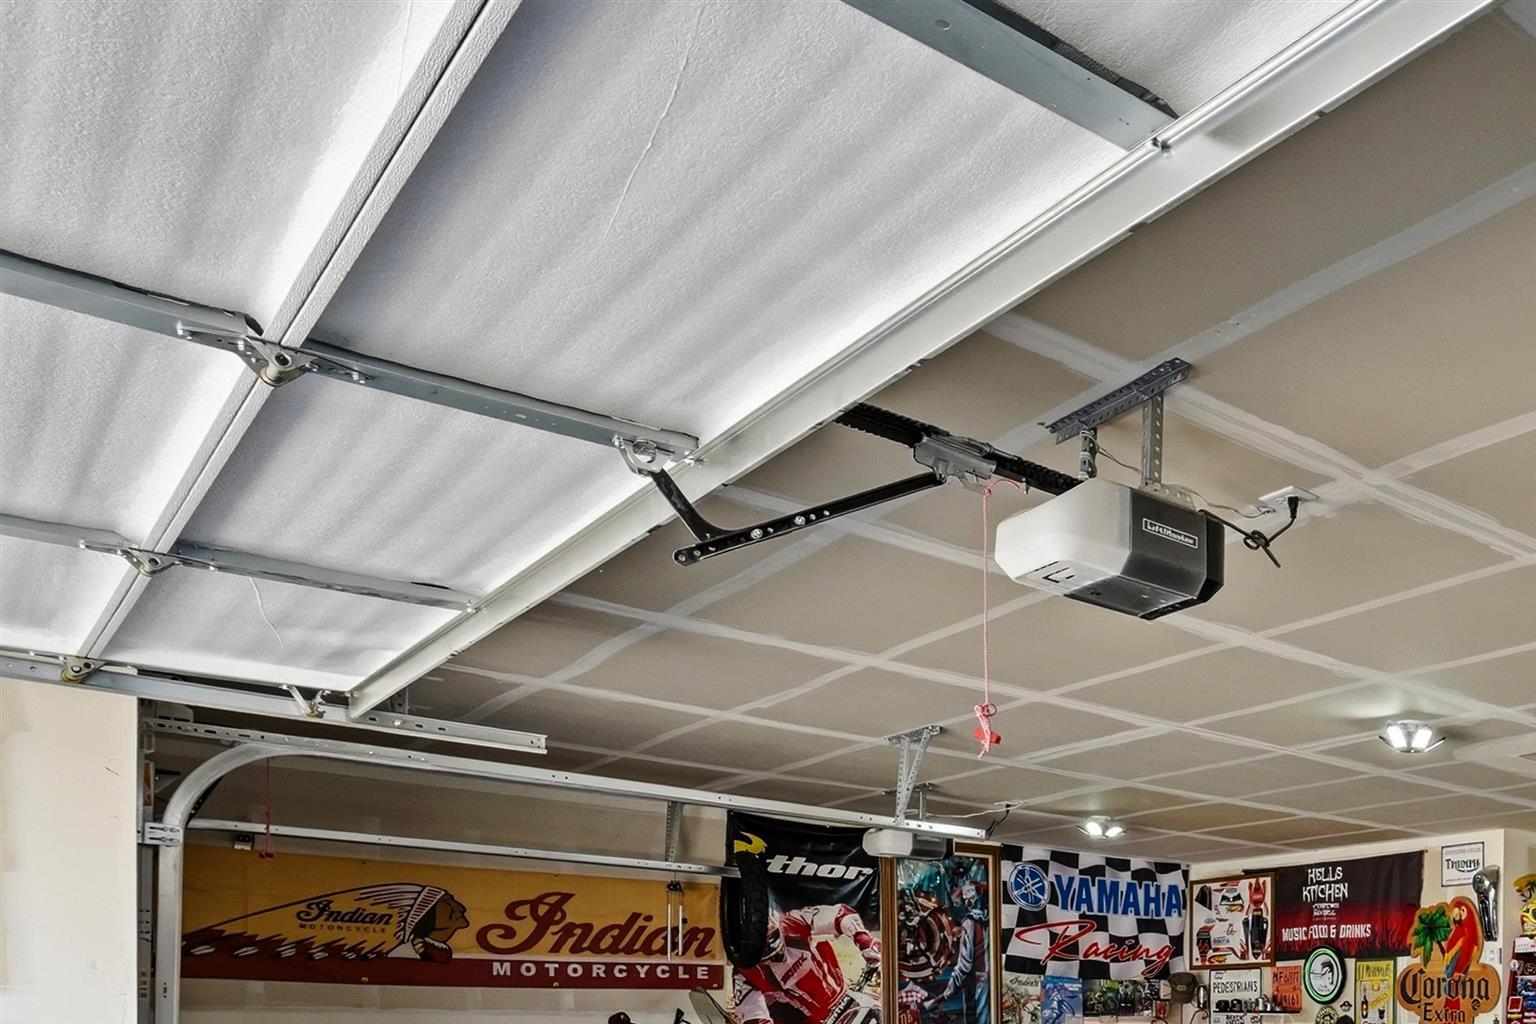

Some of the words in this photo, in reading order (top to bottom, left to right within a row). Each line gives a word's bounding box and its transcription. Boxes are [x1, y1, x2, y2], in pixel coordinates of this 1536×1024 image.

[765, 854, 874, 880] thor
[1307, 866, 1344, 885] HELLS
[1053, 873, 1183, 918] YAMAHA
[1302, 882, 1349, 902] KITCHEN
[296, 899, 394, 926] Indian
[298, 923, 387, 934] MOTORCYCLE
[475, 891, 718, 958] Indian
[1282, 926, 1308, 942] MUSIC
[1339, 923, 1372, 939] DRINKS
[1014, 918, 1176, 979] Racing
[492, 961, 709, 979] MOTORCYCLE
[1212, 980, 1258, 994] PEDESTRIANS
[1400, 967, 1490, 1005] Corona
[1422, 1001, 1466, 1023] Extra
